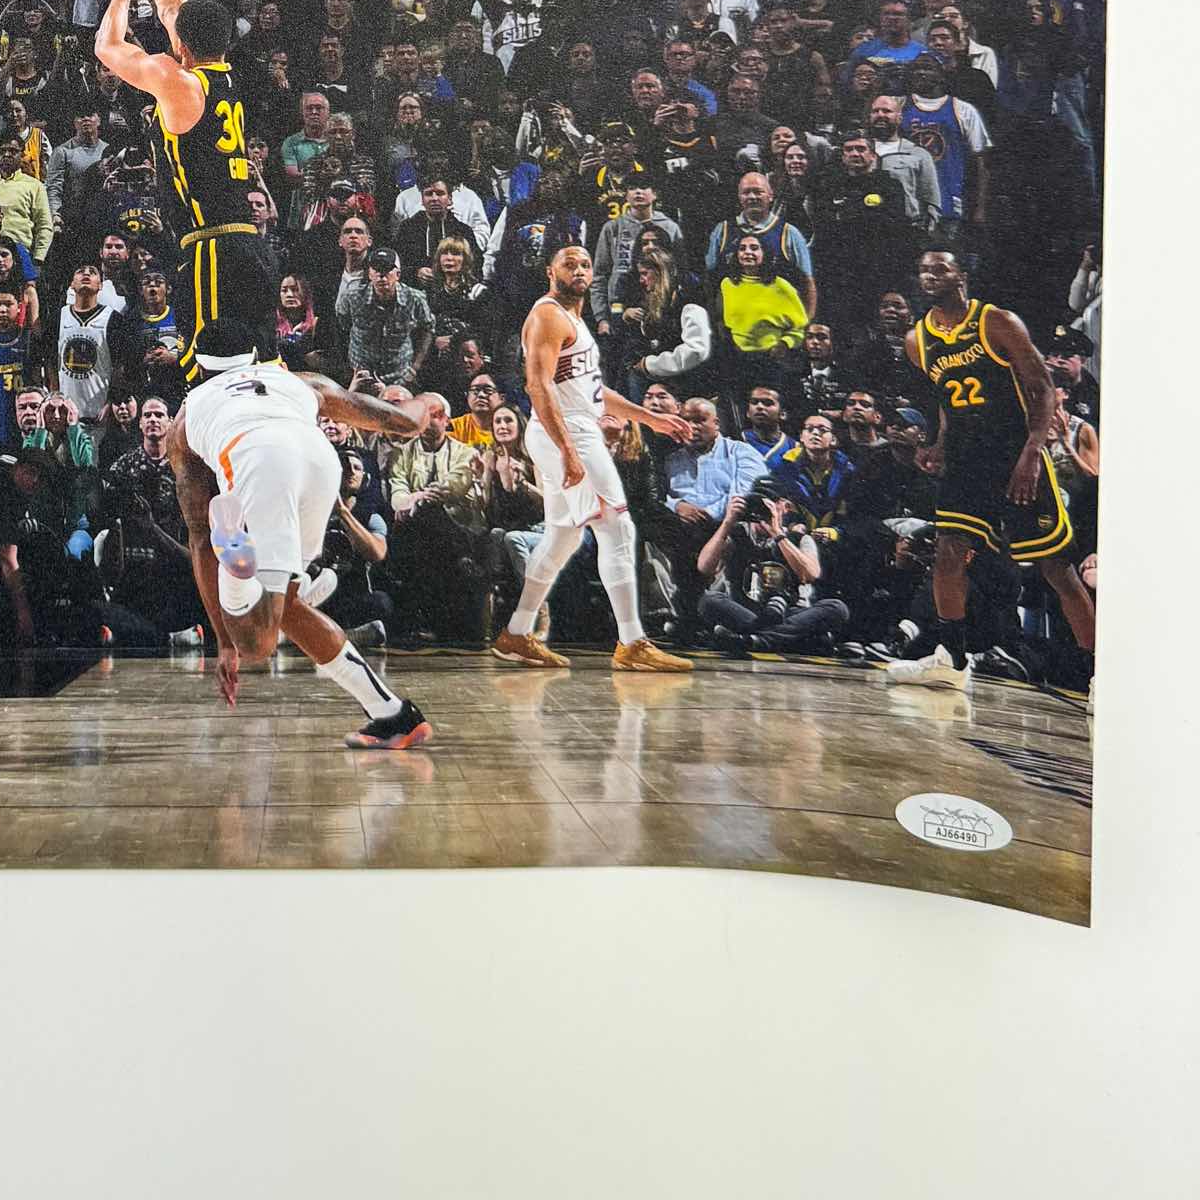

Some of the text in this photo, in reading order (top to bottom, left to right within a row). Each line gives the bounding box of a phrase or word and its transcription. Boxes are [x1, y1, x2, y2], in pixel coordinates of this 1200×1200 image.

[937, 343, 985, 370] FRANCISCO
[945, 377, 985, 407] 22
[936, 827, 978, 843] AJ66490
